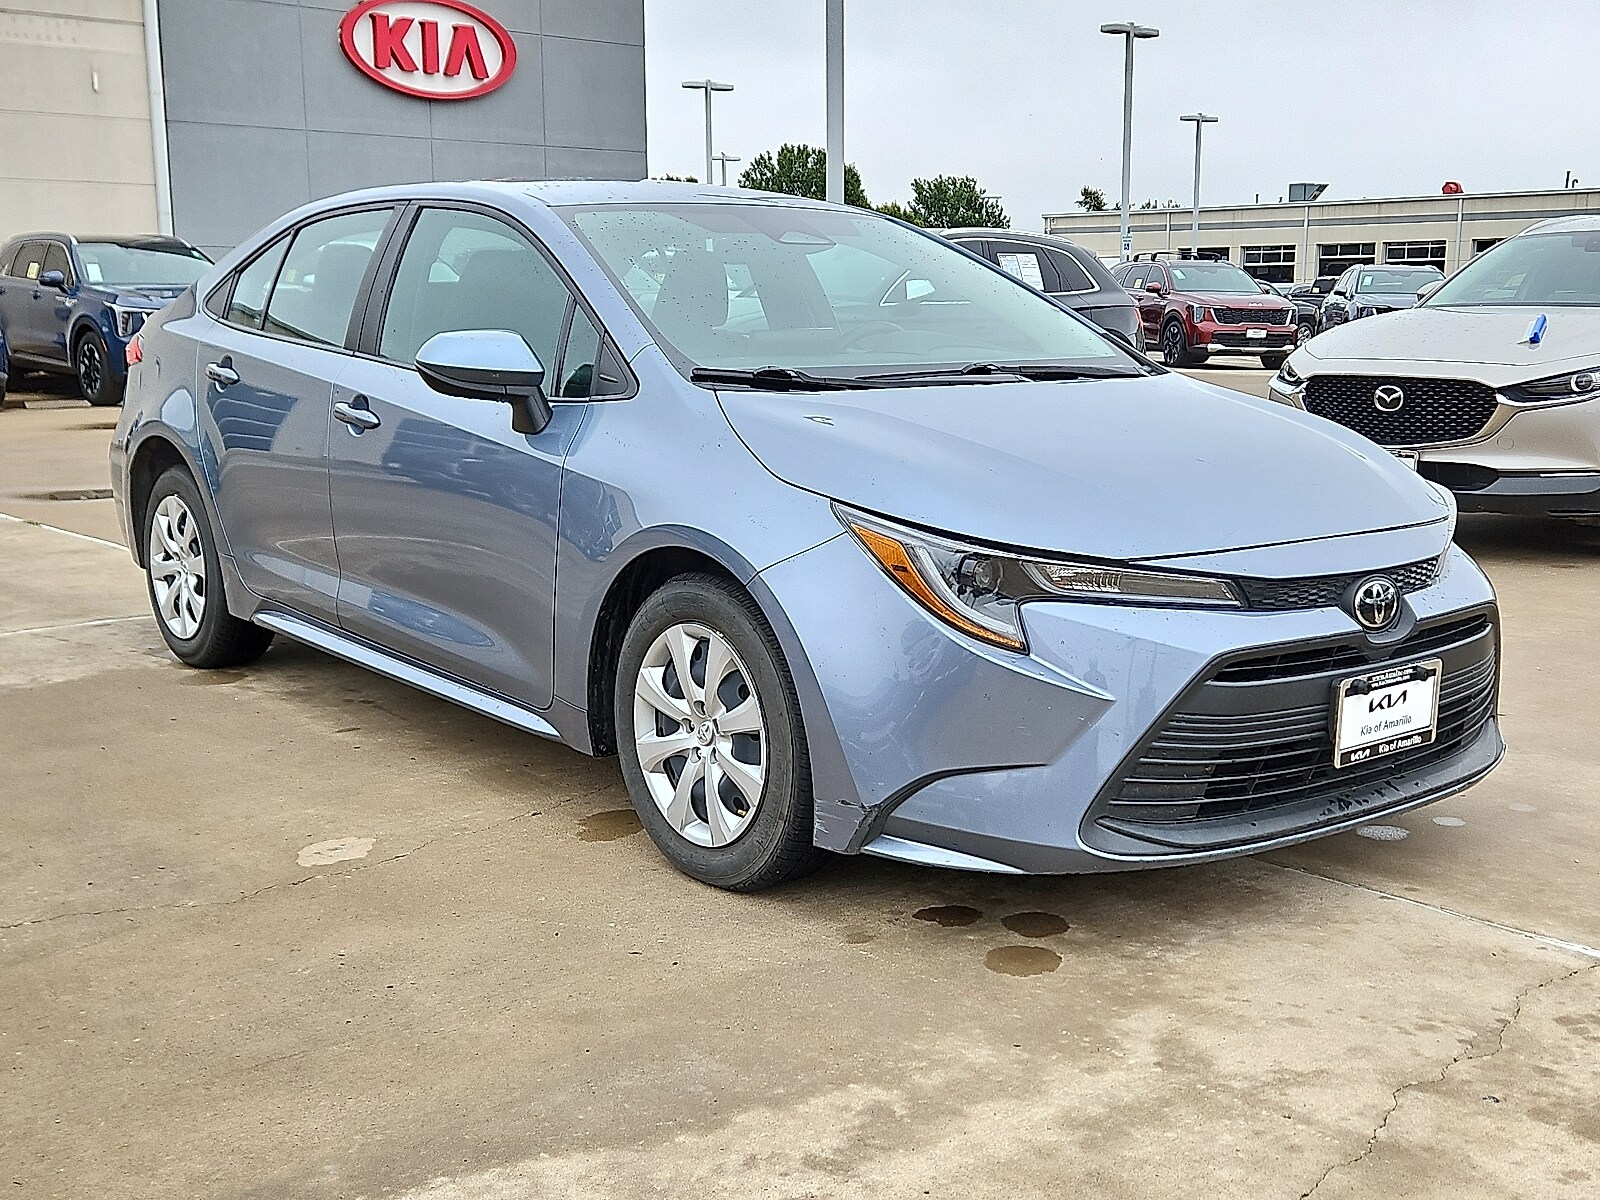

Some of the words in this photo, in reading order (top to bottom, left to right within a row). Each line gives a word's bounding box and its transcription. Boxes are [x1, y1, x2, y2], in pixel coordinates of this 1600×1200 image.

[369, 12, 489, 80] KIA
[1360, 725, 1372, 737] Kia
[1374, 721, 1381, 733] of
[1382, 715, 1412, 730] Amarillo
[1378, 744, 1390, 754] Kia
[1390, 740, 1398, 751] of
[1397, 735, 1422, 749] Amarillo
